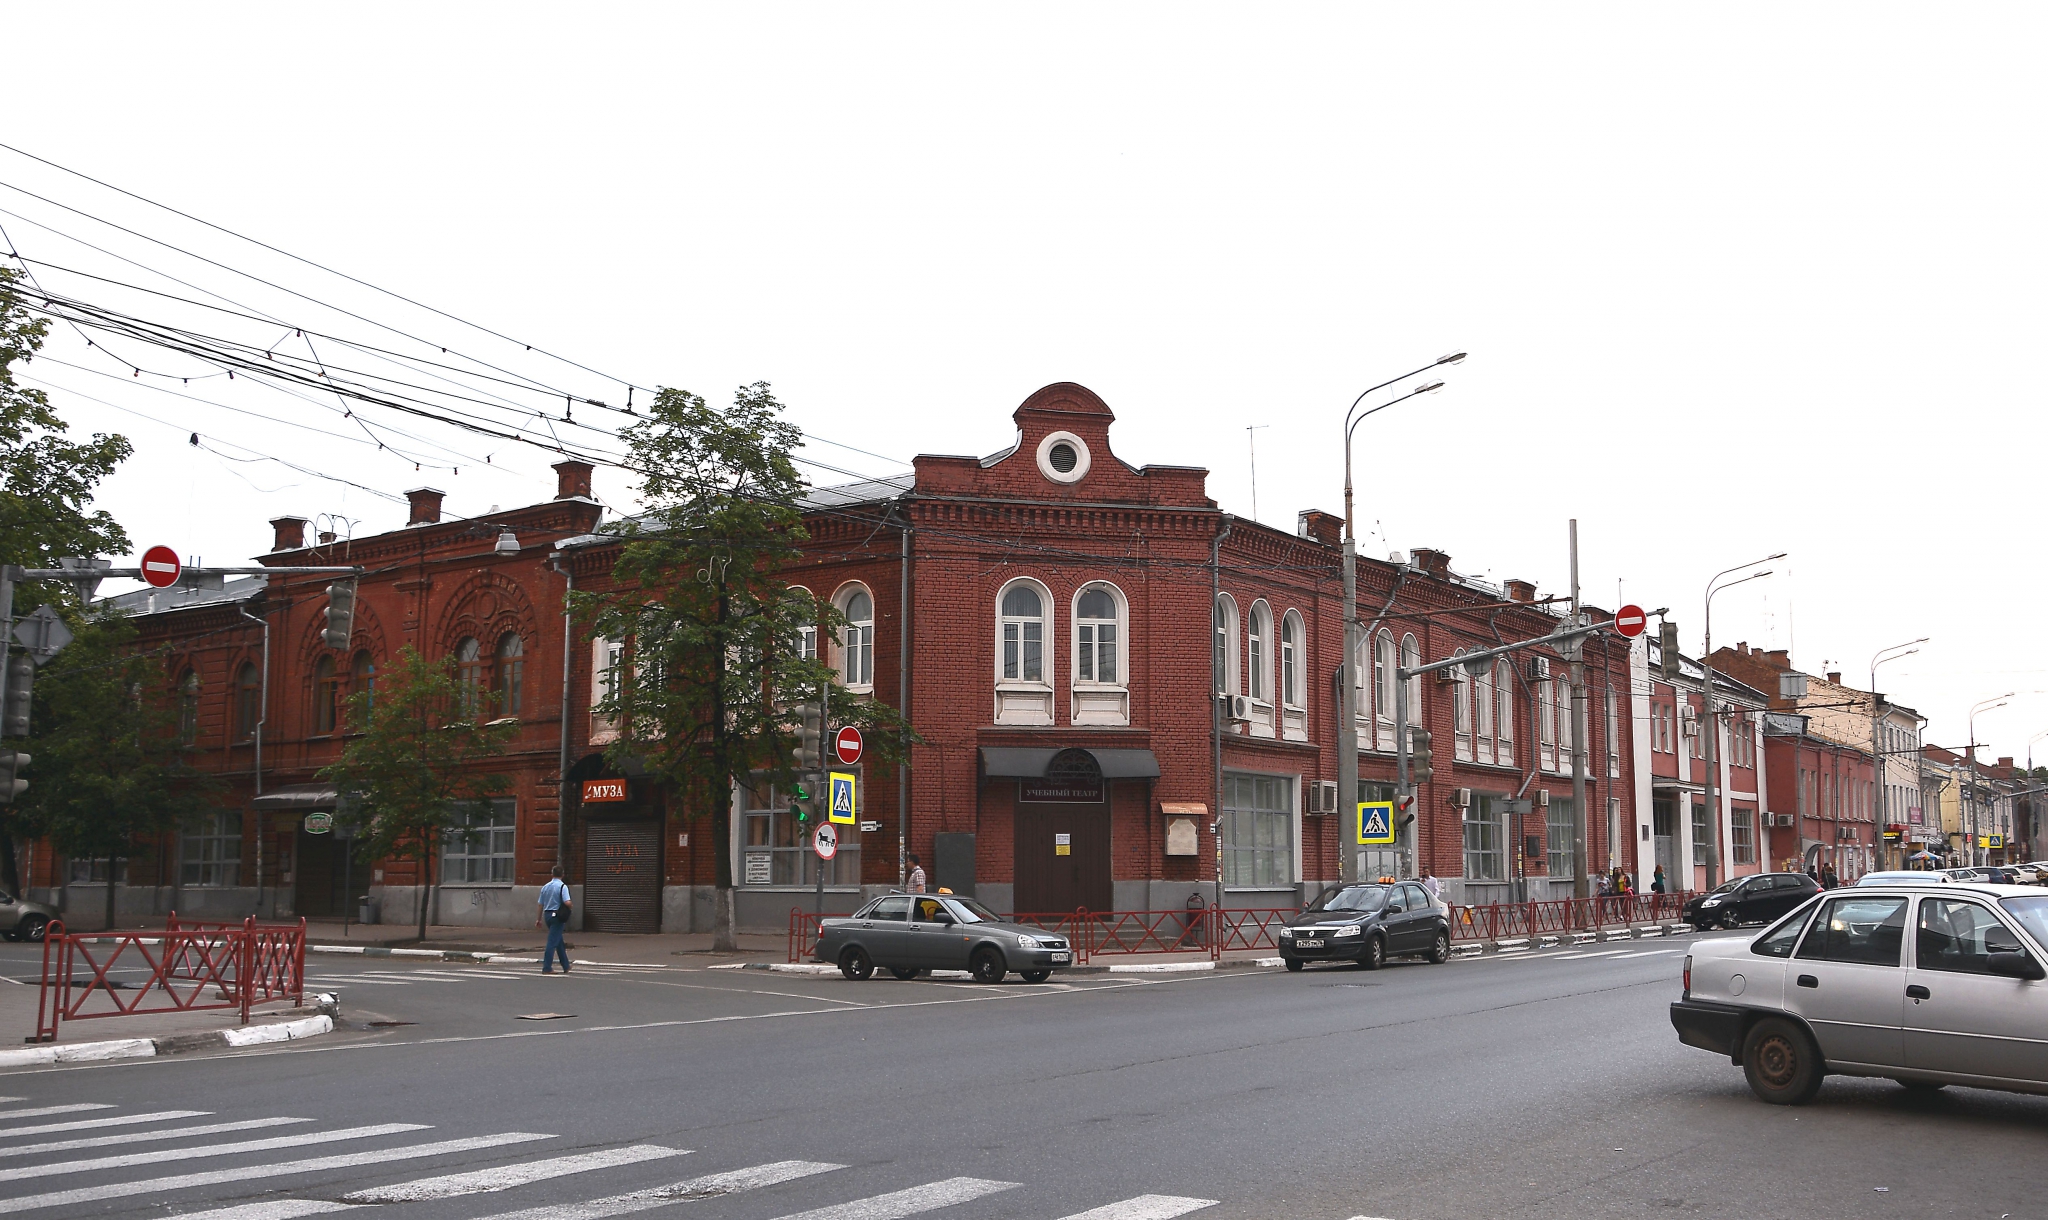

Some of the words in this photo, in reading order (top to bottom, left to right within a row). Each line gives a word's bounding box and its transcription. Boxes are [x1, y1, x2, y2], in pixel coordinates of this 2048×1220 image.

[593, 785, 624, 798] МУЗА
[1026, 788, 1070, 797] УЧЕБНЫЙ
[605, 844, 639, 857] МУЗА
